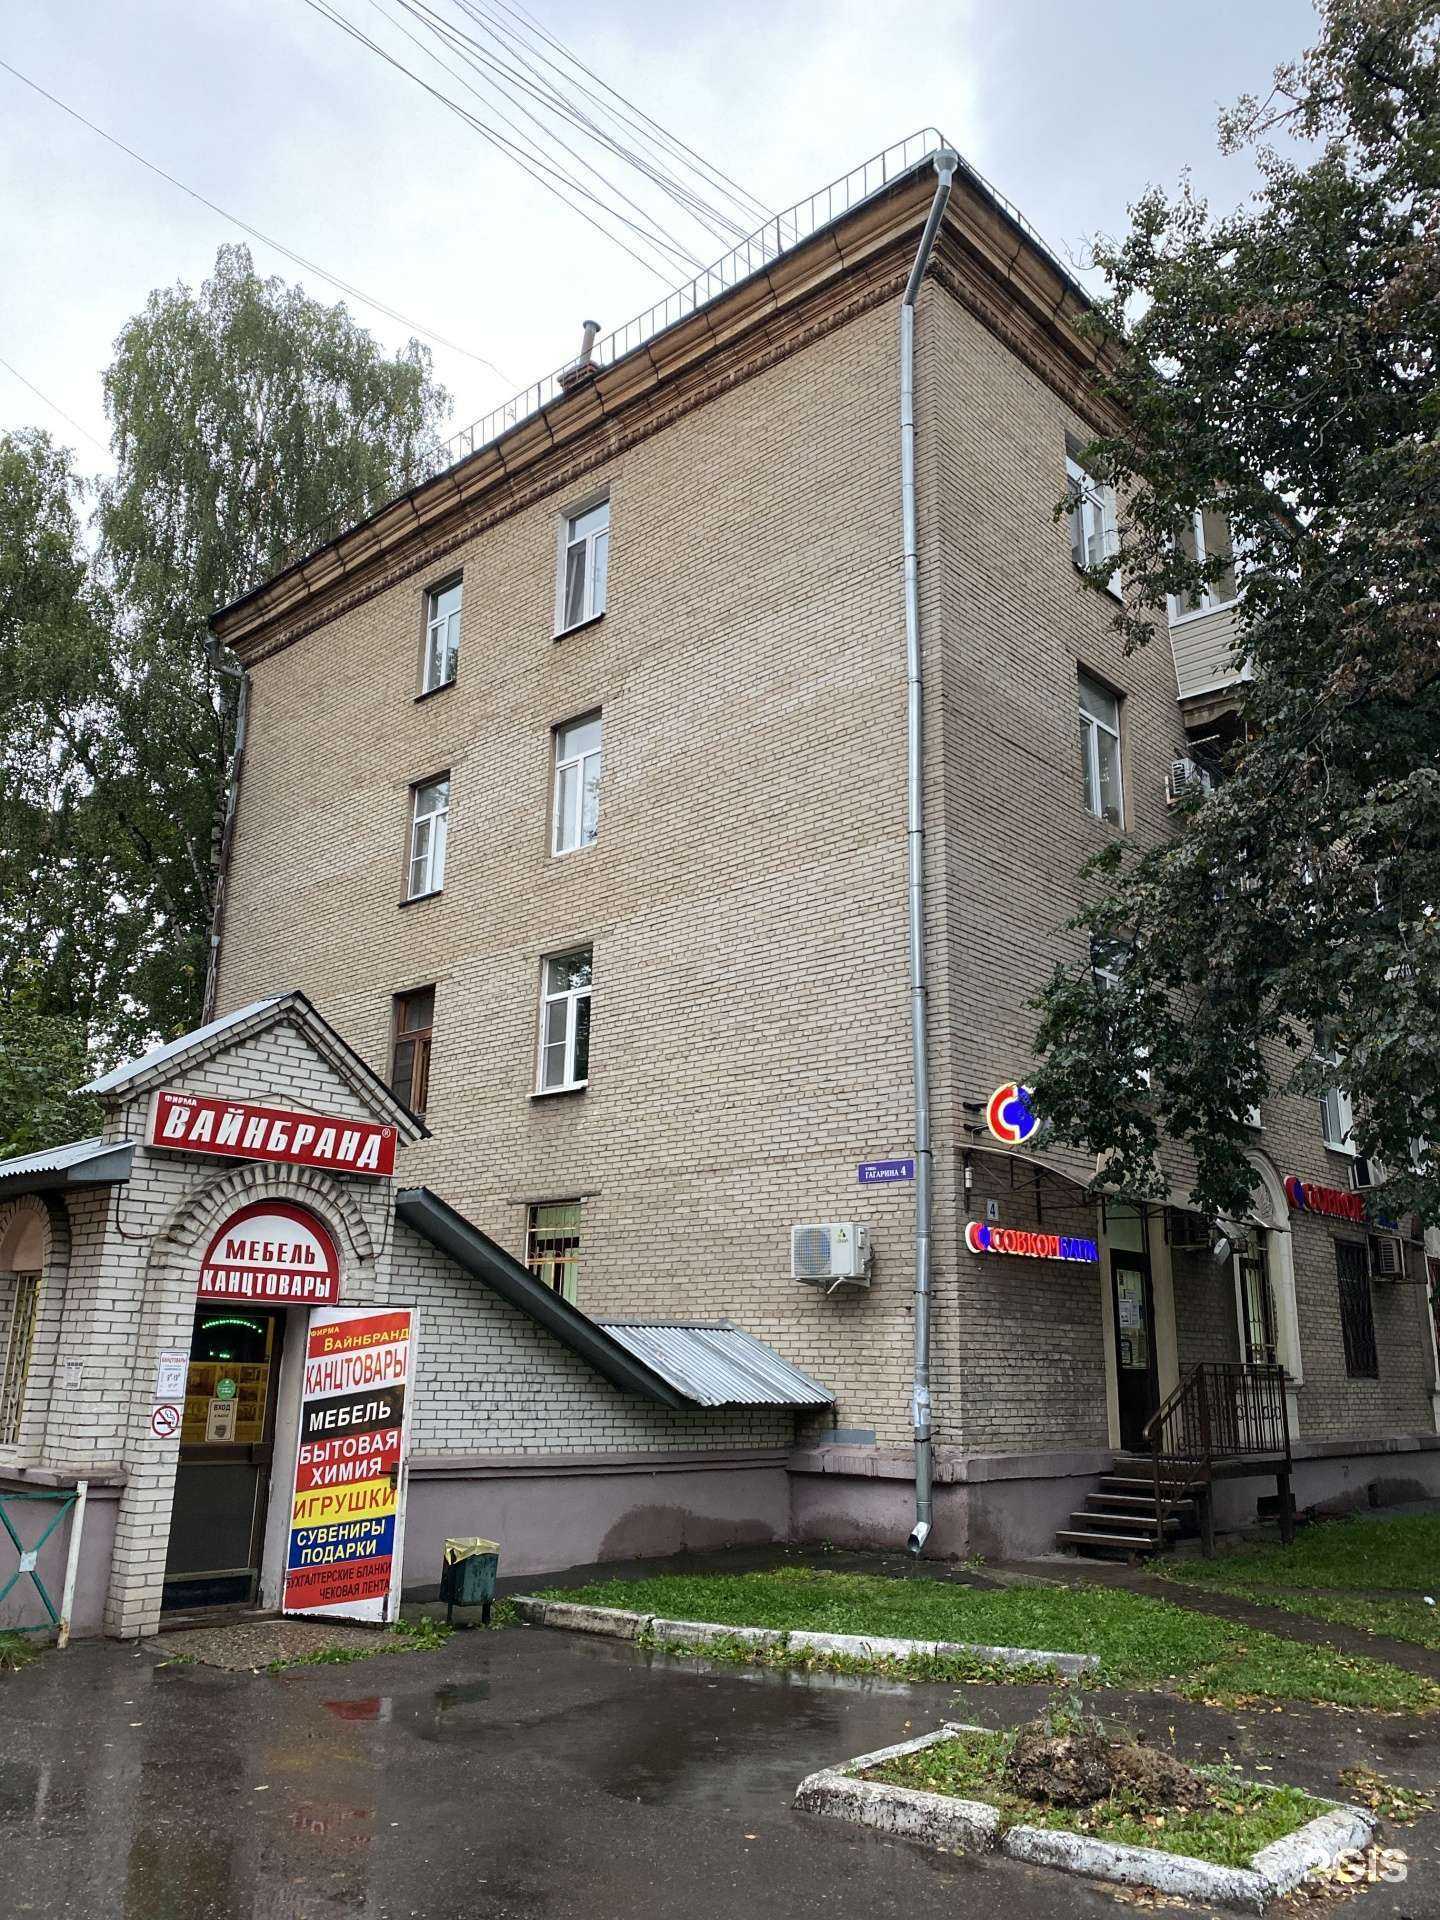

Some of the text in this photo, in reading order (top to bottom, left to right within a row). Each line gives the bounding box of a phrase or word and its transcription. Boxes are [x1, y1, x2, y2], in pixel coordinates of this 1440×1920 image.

[164, 1095, 198, 1107] ФИРМА
[865, 1165, 907, 1179] ГАГАРИНА 4
[989, 1203, 997, 1218] 4
[225, 1239, 316, 1265] МЕБЕЛЬ
[201, 1269, 331, 1298] КАНЦТОВАРЫ
[310, 1326, 340, 1337] ФИРМА
[323, 1328, 410, 1352] ВАЙНБРАНД
[305, 1346, 408, 1395] КАНЦТОВАРЫ
[309, 1400, 391, 1432] МЕБЕЛЬ
[300, 1431, 399, 1465] БЫТОВАЯ
[310, 1457, 382, 1487] ХИМИЯ
[294, 1486, 396, 1520] ИГРУШКИ
[297, 1519, 386, 1546] СУВЕНИРЫ
[301, 1539, 377, 1565] ПОДАРКИ
[286, 1562, 392, 1589] БУХГАЛТЕРСКИЕ БЛАНКИ
[319, 1578, 390, 1601] ЧЕКОВАЯ ЛЕНТА
